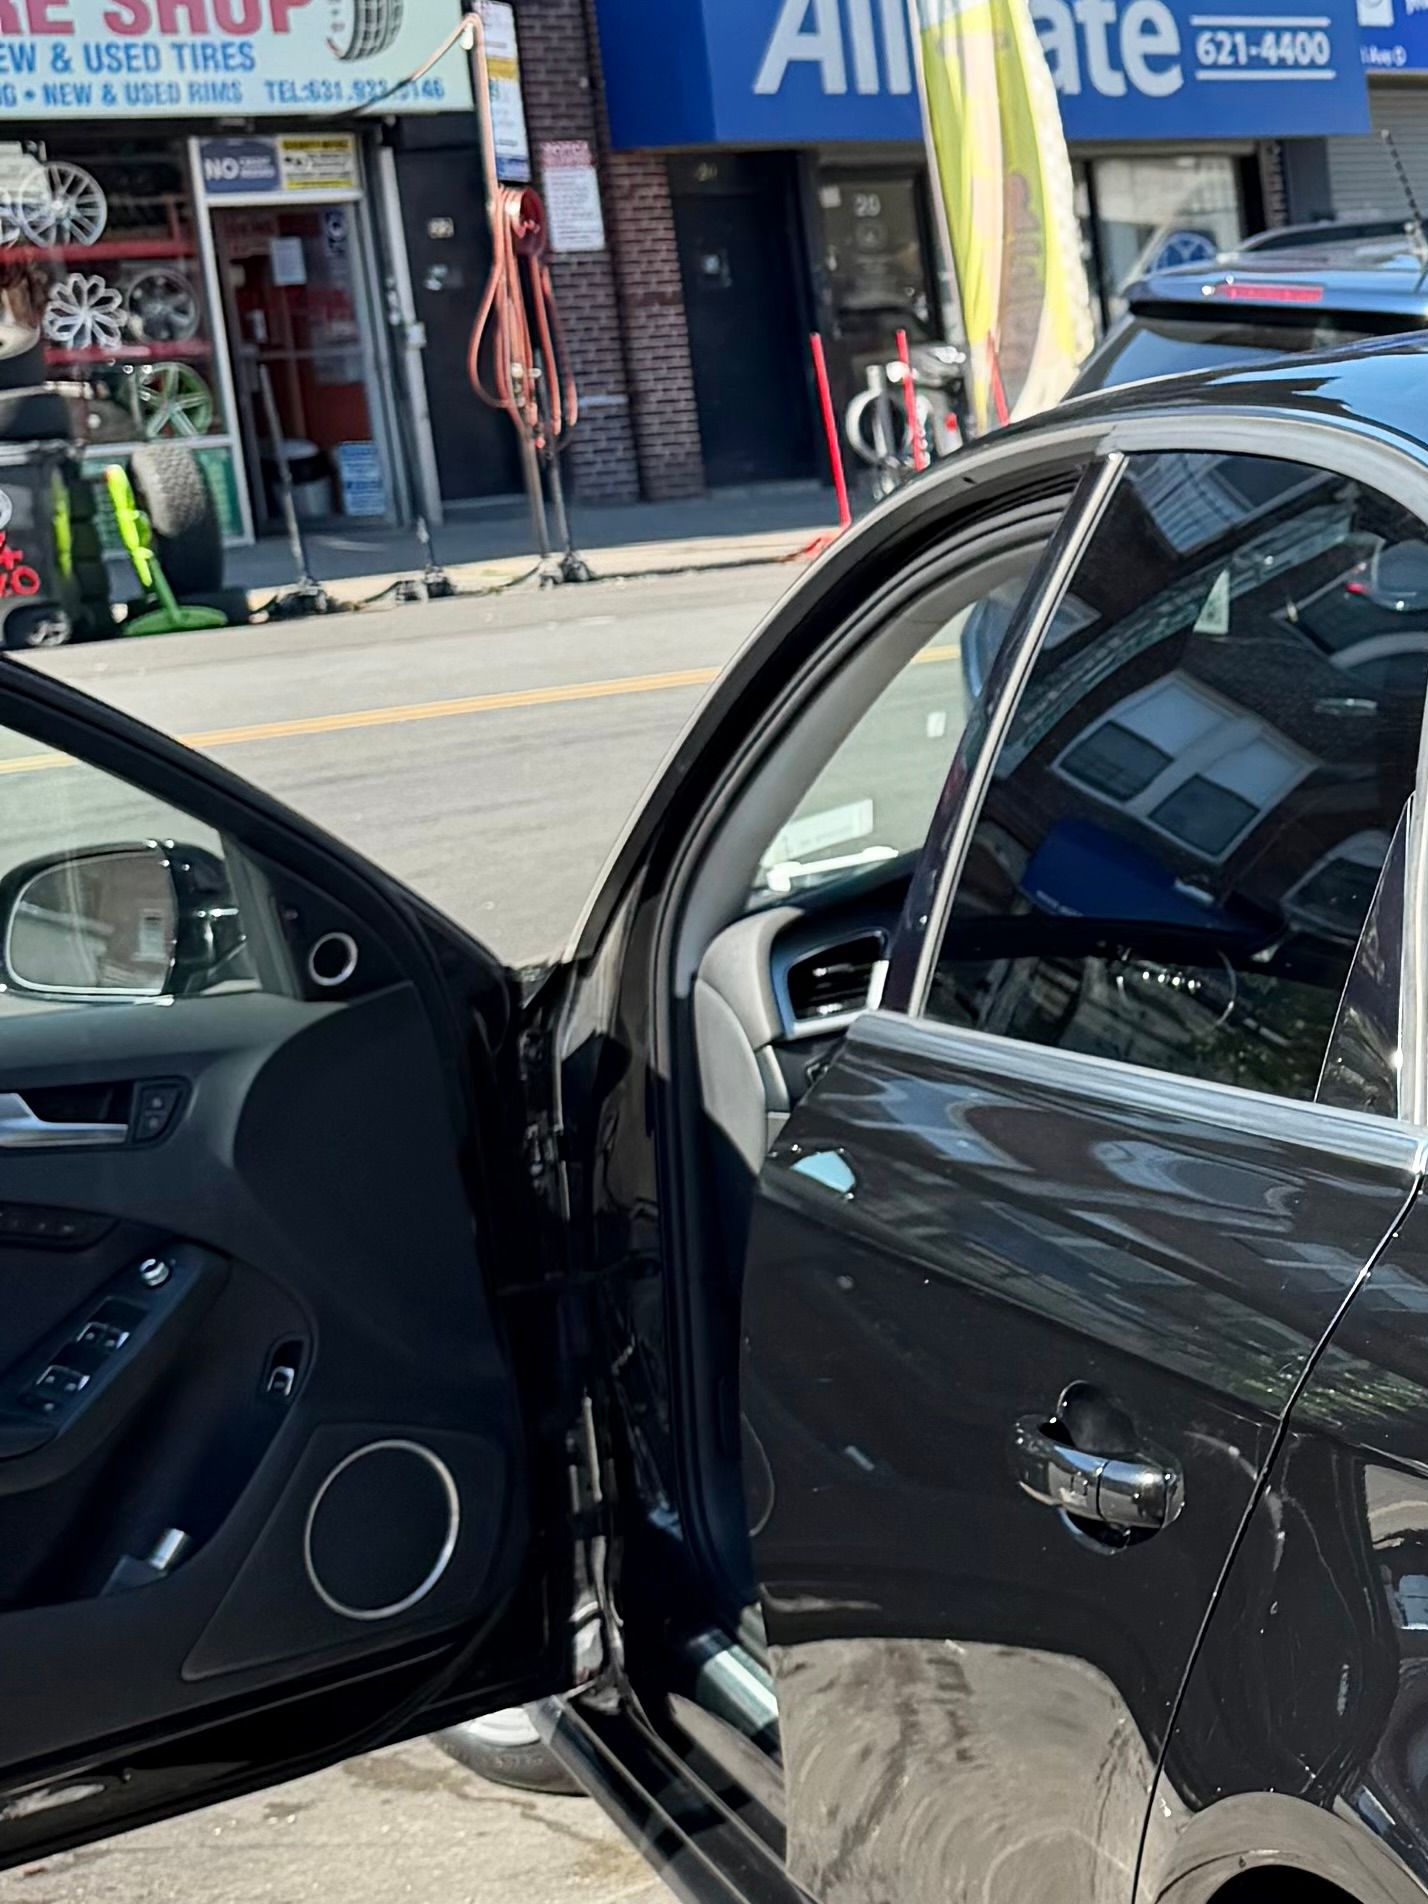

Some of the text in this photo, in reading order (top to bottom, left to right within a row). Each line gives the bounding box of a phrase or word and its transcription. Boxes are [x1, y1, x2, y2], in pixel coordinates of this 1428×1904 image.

[50, 42, 73, 74] &
[84, 42, 161, 74] USED
[171, 42, 256, 73] TIRES
[1199, 29, 1330, 67] 621-4400
[43, 81, 93, 106] NEW
